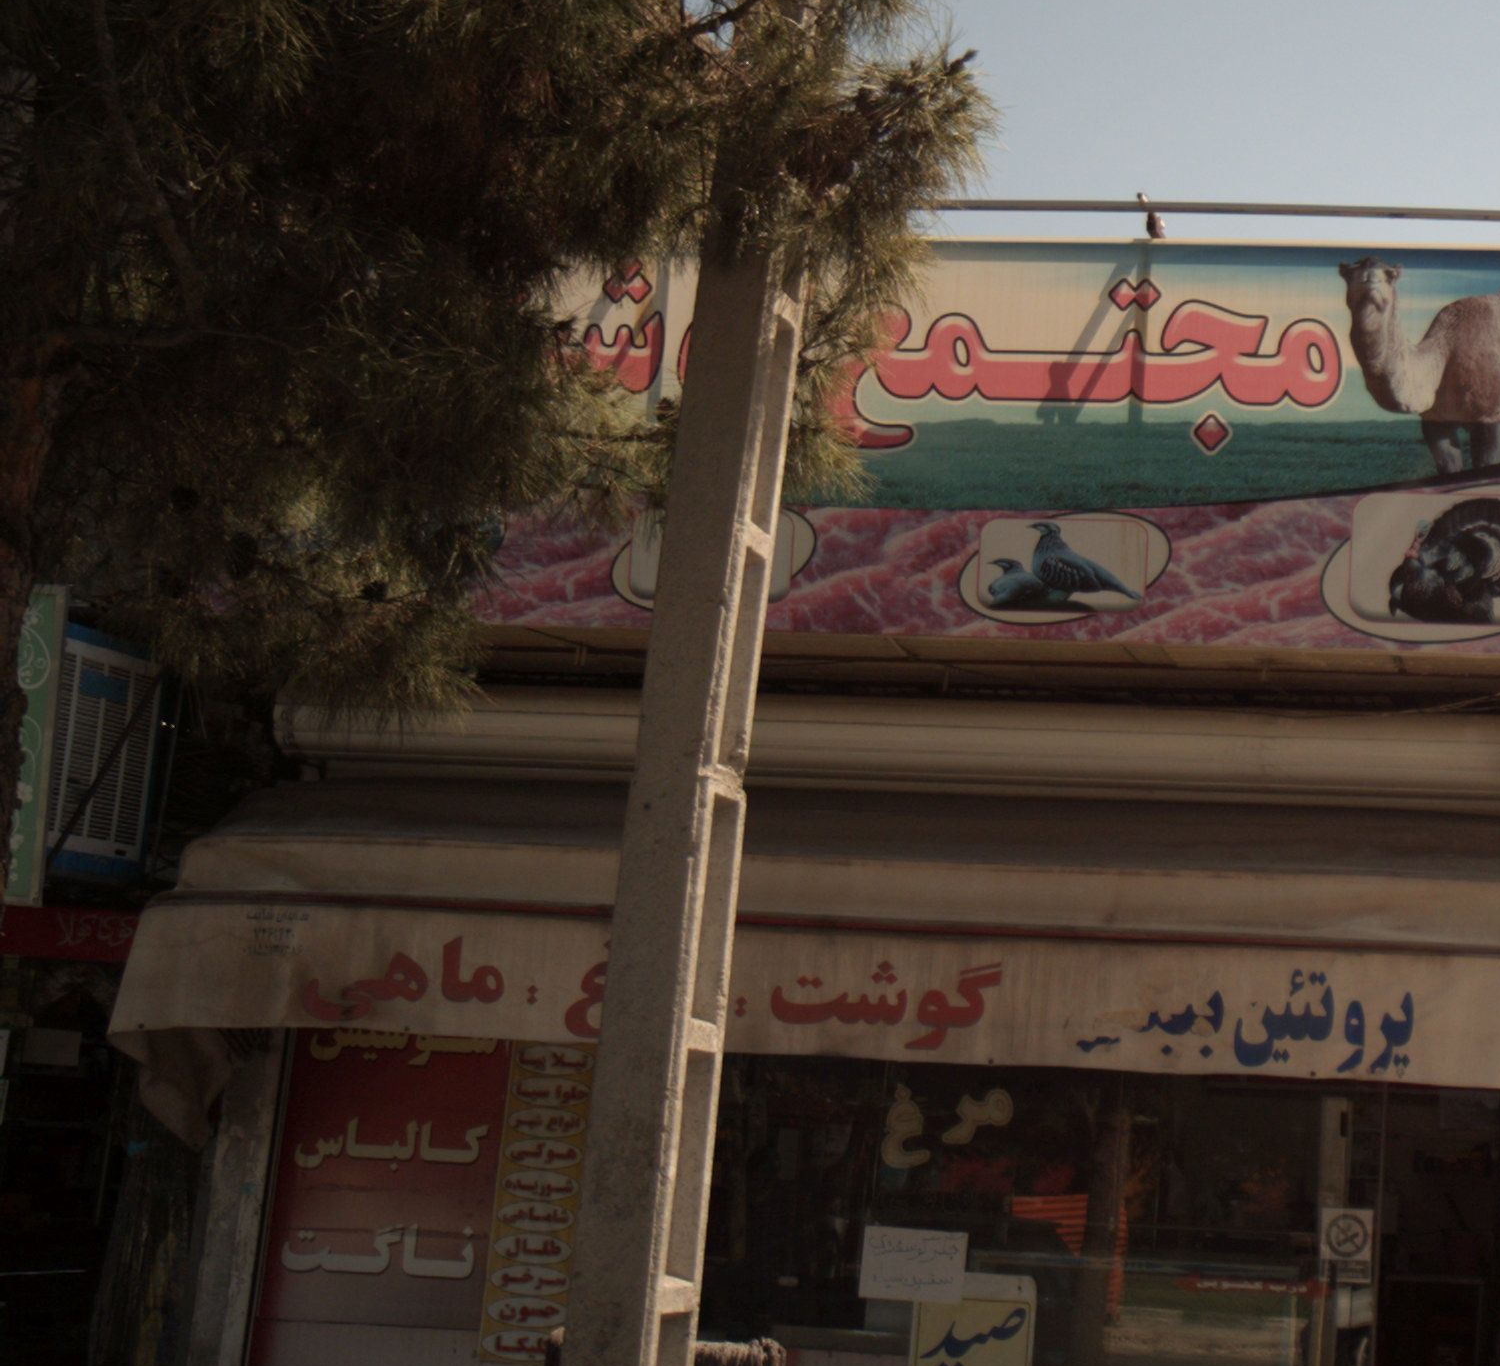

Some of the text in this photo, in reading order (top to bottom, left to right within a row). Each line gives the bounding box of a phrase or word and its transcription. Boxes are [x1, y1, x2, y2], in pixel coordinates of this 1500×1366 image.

[301, 937, 507, 1022] ماهی
[770, 959, 1002, 1052] گوشت
[1233, 967, 1417, 1075] پروتئین
[293, 1115, 490, 1173] کالباس
[879, 1082, 1014, 1170] مرغ
